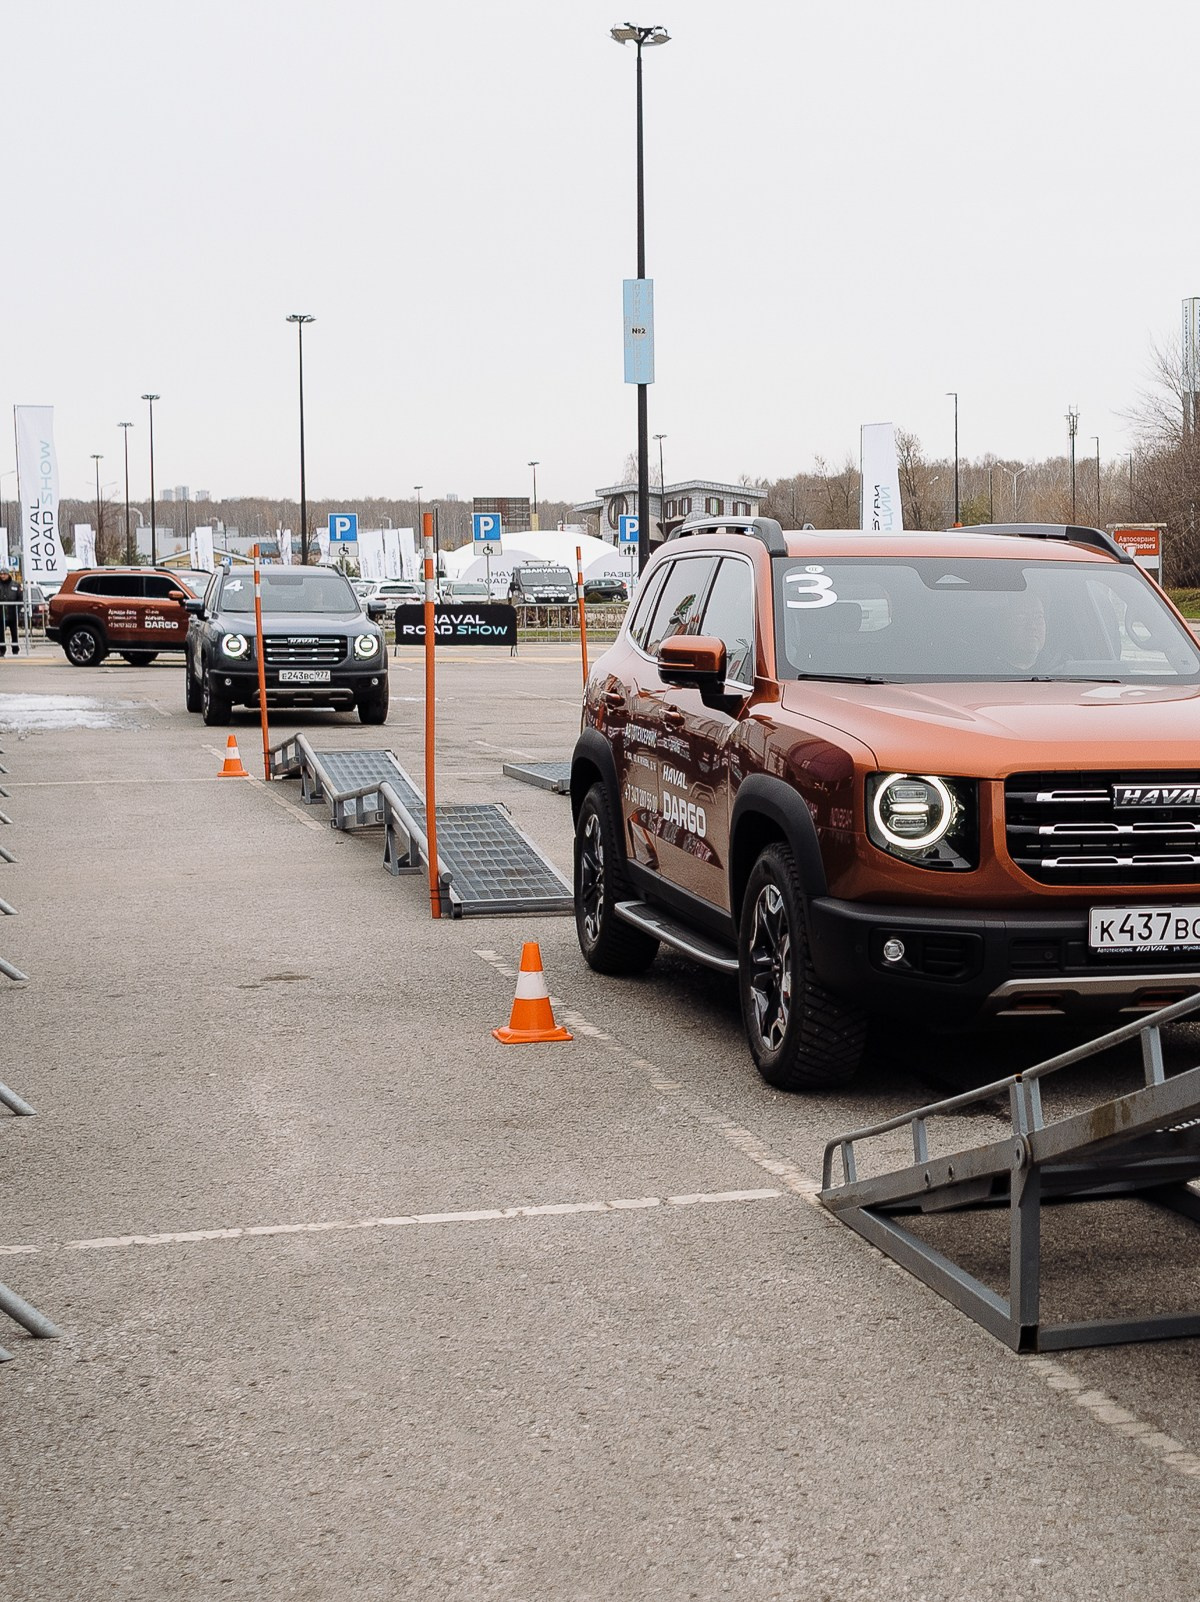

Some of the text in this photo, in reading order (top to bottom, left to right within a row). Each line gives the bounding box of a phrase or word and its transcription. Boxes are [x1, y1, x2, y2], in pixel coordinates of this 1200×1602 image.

[40, 440, 58, 572] ROAD SHOW
[30, 498, 43, 571] HAVAL
[335, 517, 351, 540] P
[480, 516, 494, 539] P
[625, 518, 639, 540] P
[224, 579, 244, 592] 4
[785, 573, 838, 609] 3
[144, 621, 179, 629] DARGO
[456, 625, 508, 635] SHOW
[662, 764, 689, 790] HAVAL
[662, 790, 707, 838] DARGO
[1136, 944, 1169, 952] HAVAL
